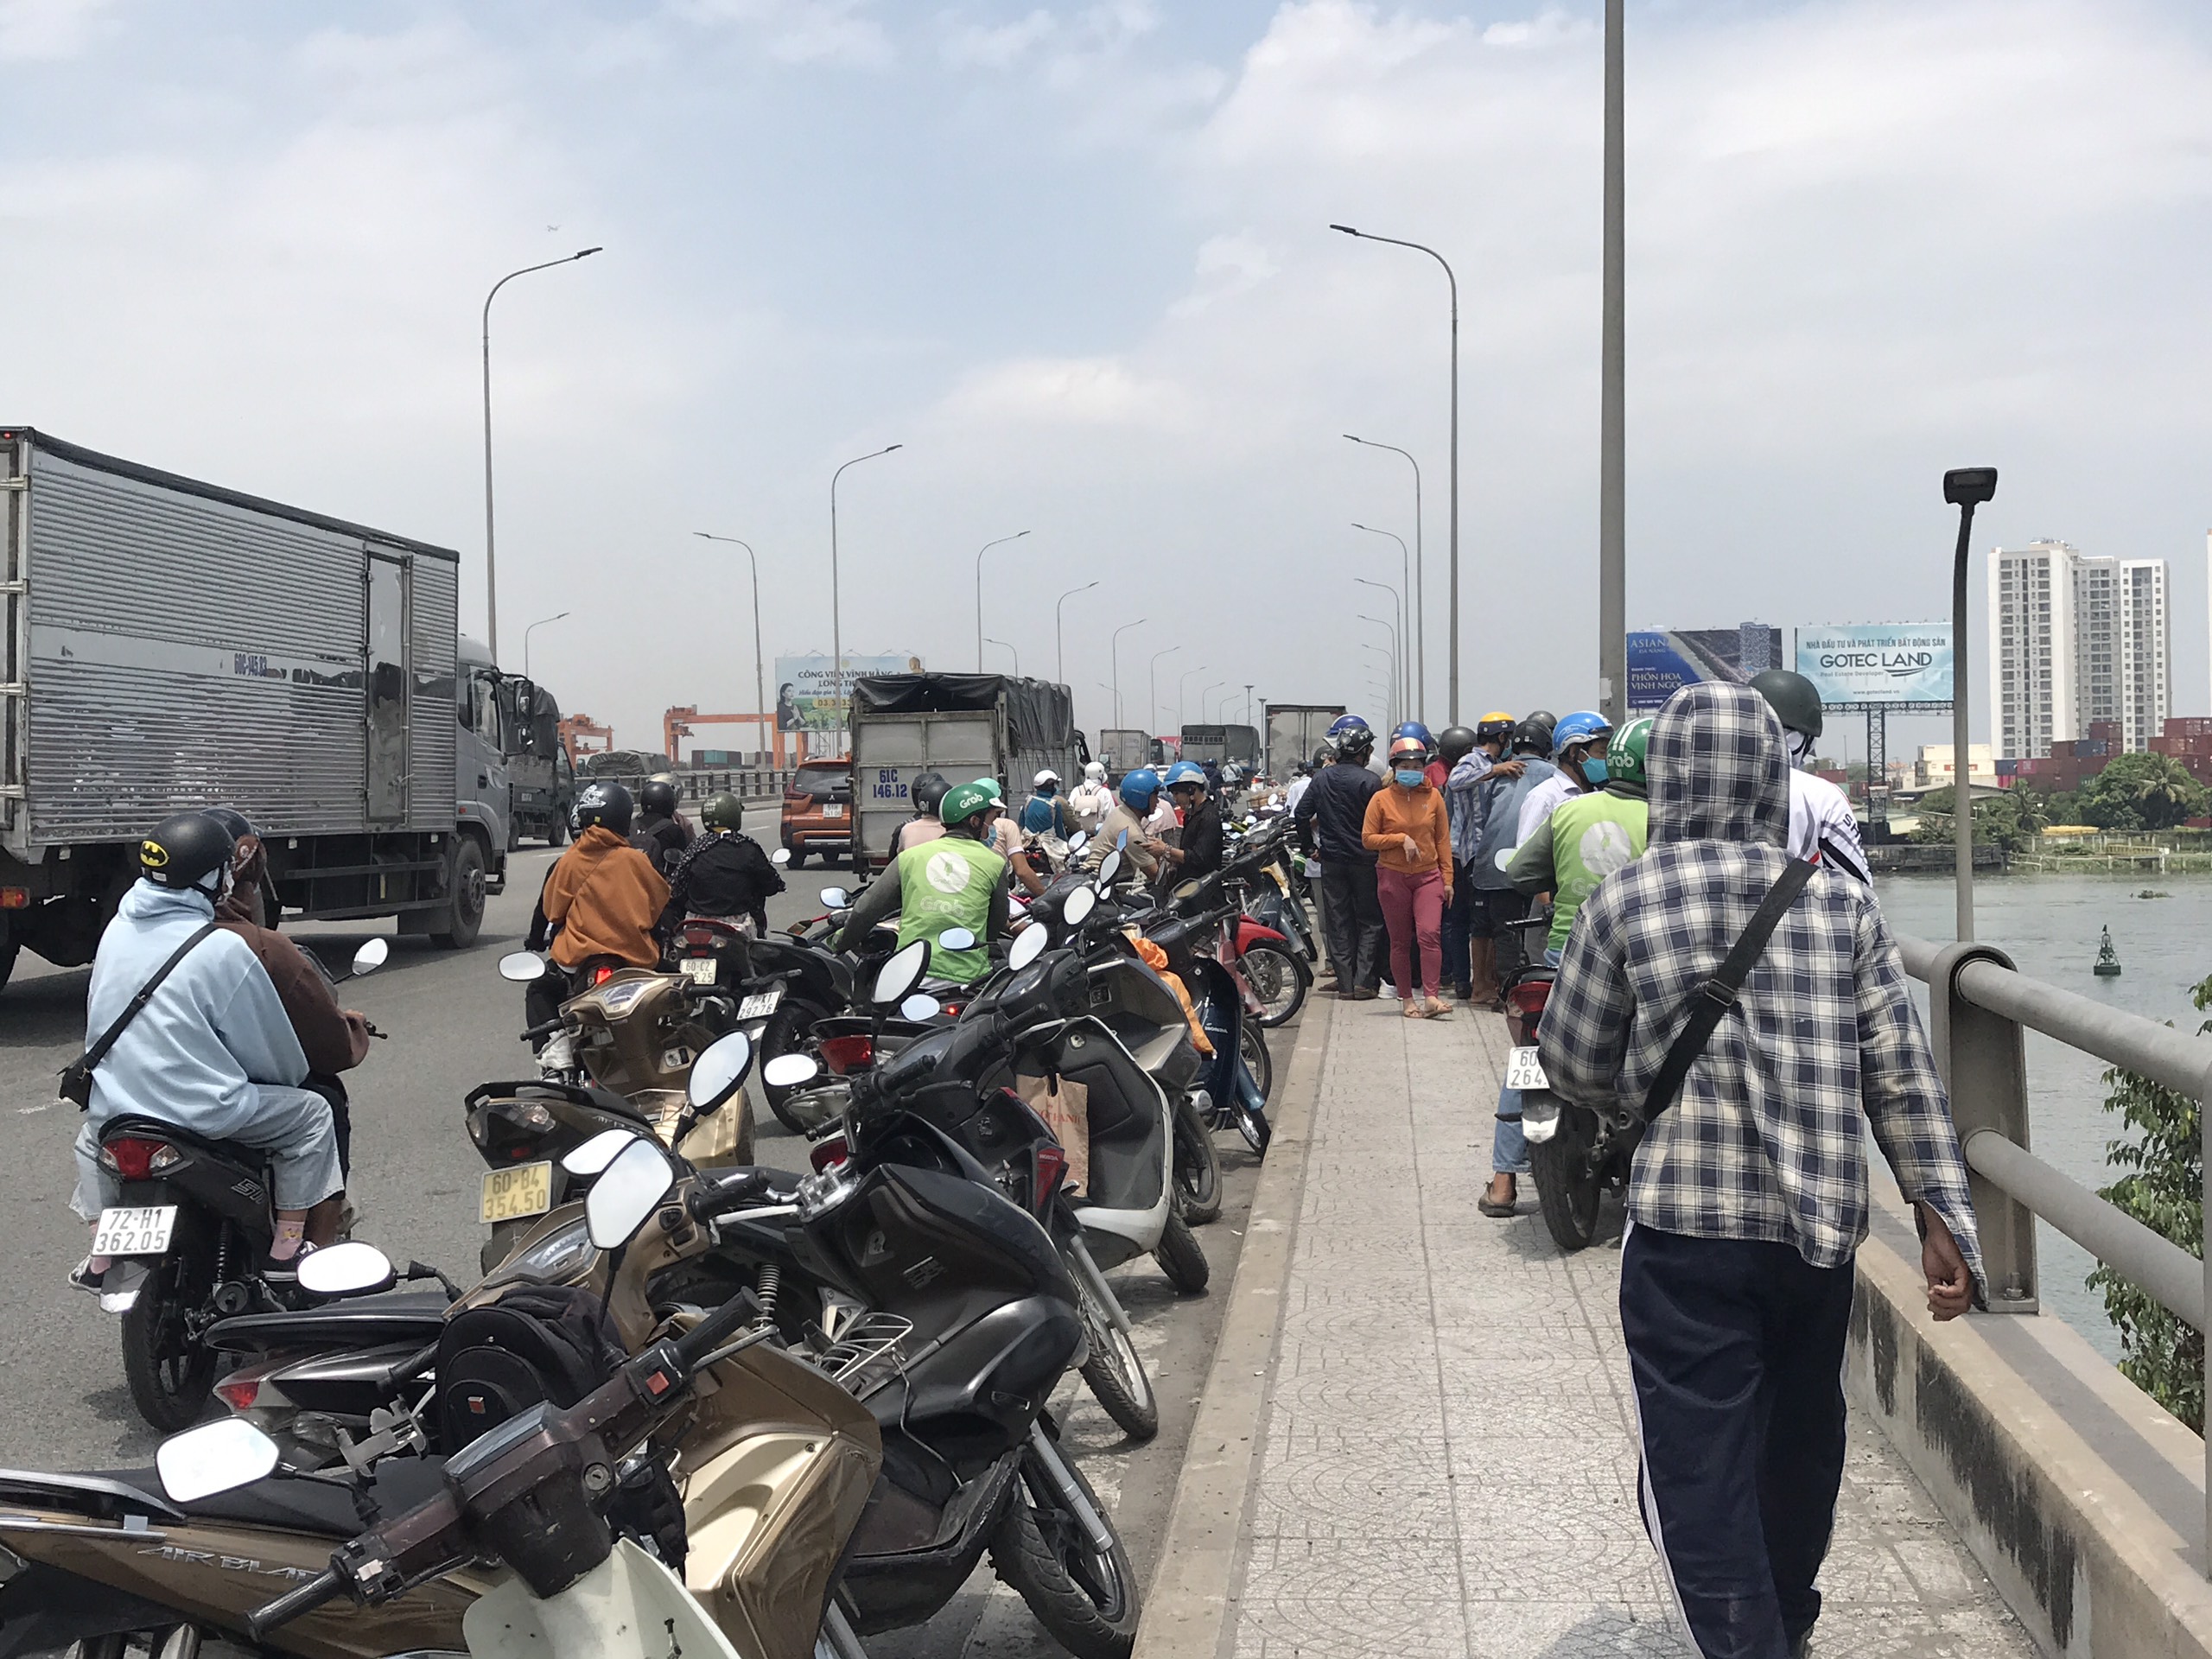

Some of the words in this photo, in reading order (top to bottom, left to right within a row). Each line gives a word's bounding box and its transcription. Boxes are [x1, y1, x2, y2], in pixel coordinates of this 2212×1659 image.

[1630, 639, 1666, 648] ASIAN
[1806, 640, 1821, 649] NHÀ
[1847, 639, 1856, 648] VÀ
[1858, 638, 1875, 648] PHÁT
[1877, 636, 1897, 647] TRIỂN
[1932, 636, 1946, 646] SẢN
[1820, 653, 1878, 668] GOTEC
[1882, 652, 1933, 666] LAND
[798, 670, 823, 678] CÔNG
[1607, 752, 1635, 768] Grab
[879, 768, 898, 784] 61C
[873, 784, 908, 798] 146.12
[959, 792, 984, 809] Grab
[920, 895, 965, 918] Grab
[686, 961, 710, 971] 60-C2
[493, 1166, 539, 1195] 60-B4
[485, 1188, 546, 1219] 354.50
[109, 1208, 162, 1230] 72-H1
[96, 1230, 166, 1253] 362.05
[137, 1545, 216, 1567] AIR
